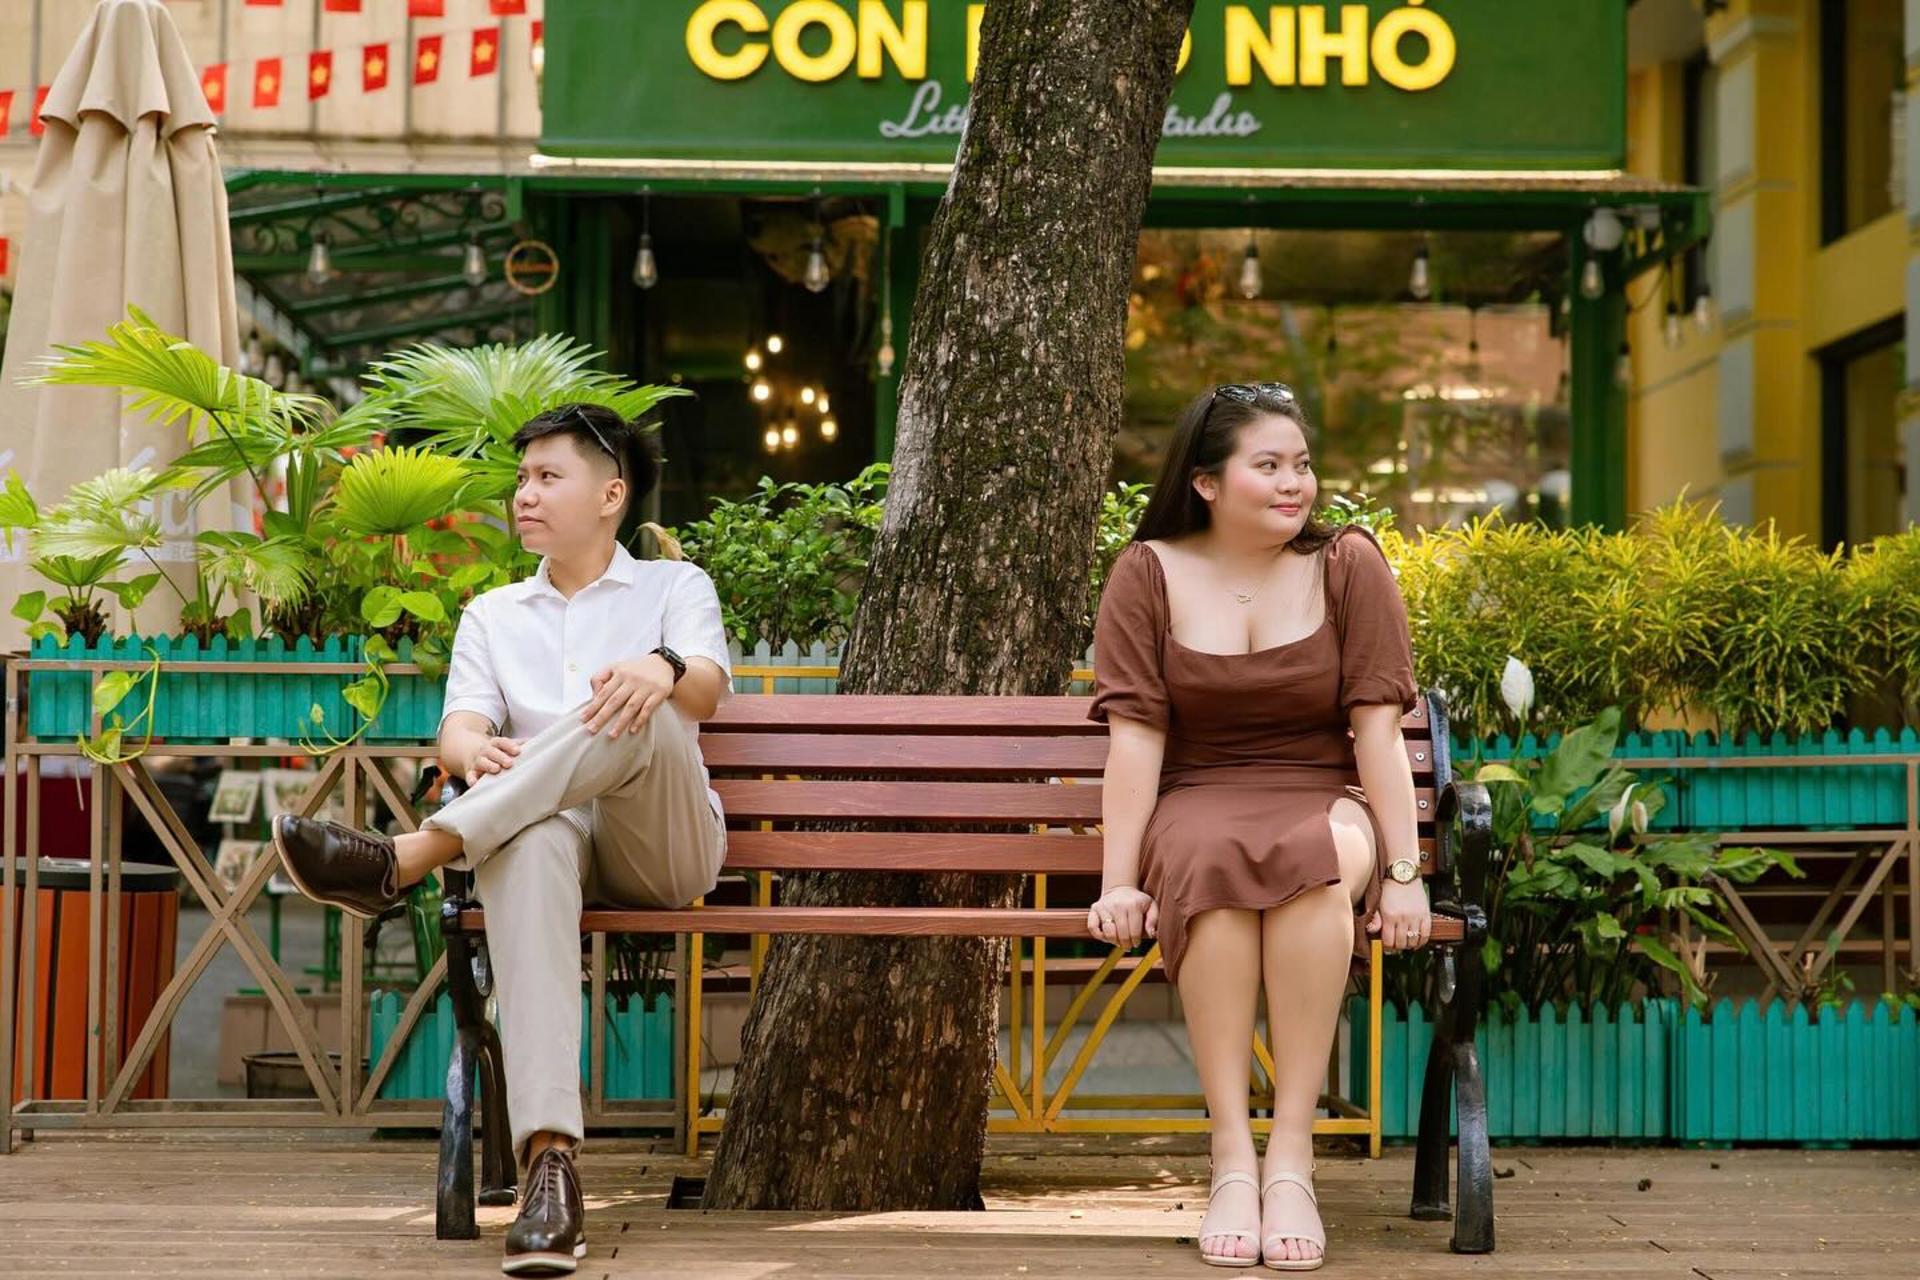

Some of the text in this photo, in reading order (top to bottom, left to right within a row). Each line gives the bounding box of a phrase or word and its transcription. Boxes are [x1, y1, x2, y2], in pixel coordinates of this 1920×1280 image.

[685, 0, 928, 82] CON
[879, 80, 1262, 138] Litt tudio
